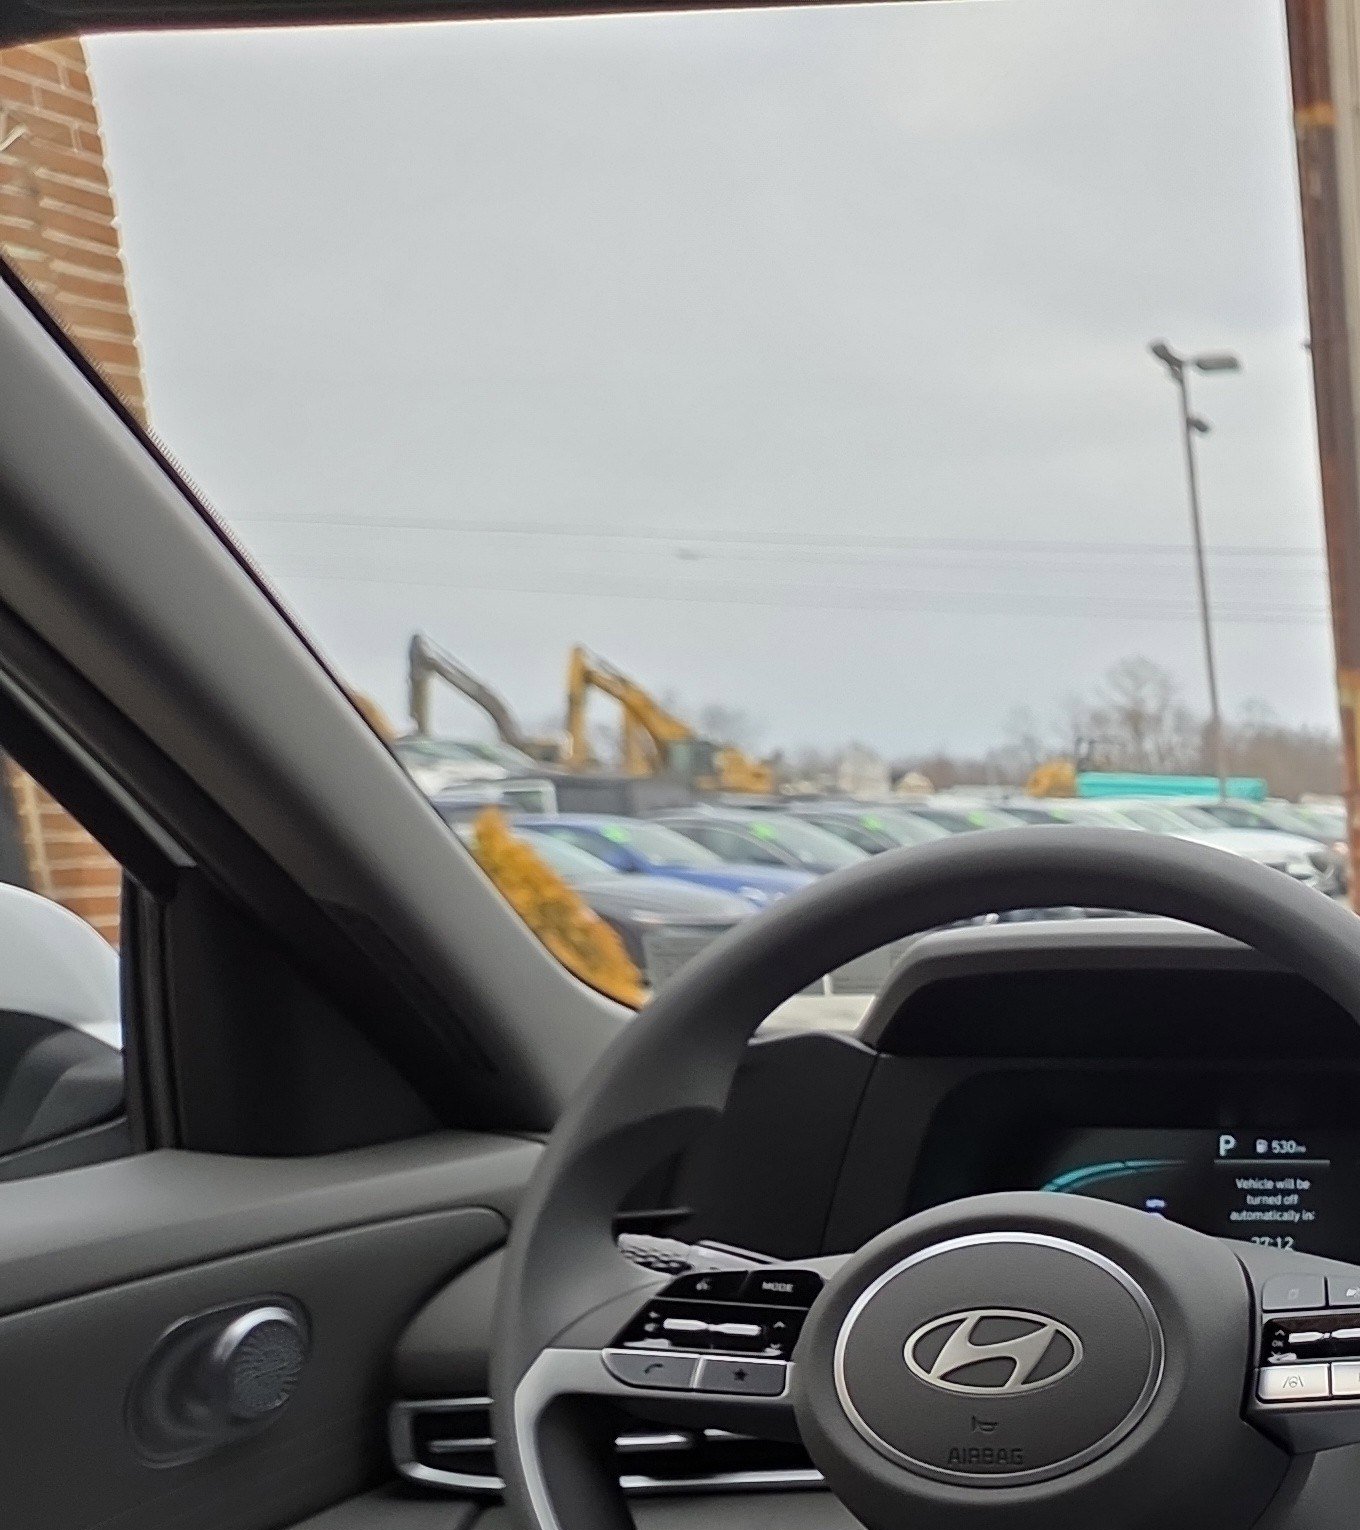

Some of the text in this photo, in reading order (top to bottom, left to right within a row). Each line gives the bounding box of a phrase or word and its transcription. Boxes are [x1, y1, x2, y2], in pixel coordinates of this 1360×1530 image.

[1219, 1134, 1236, 1156] P
[1235, 1177, 1311, 1189] Vehicle will be
[1246, 1193, 1299, 1205] turned off
[1229, 1209, 1300, 1222] automatically
[761, 1281, 794, 1294] MODE
[947, 1446, 1024, 1465] AIRBAG
